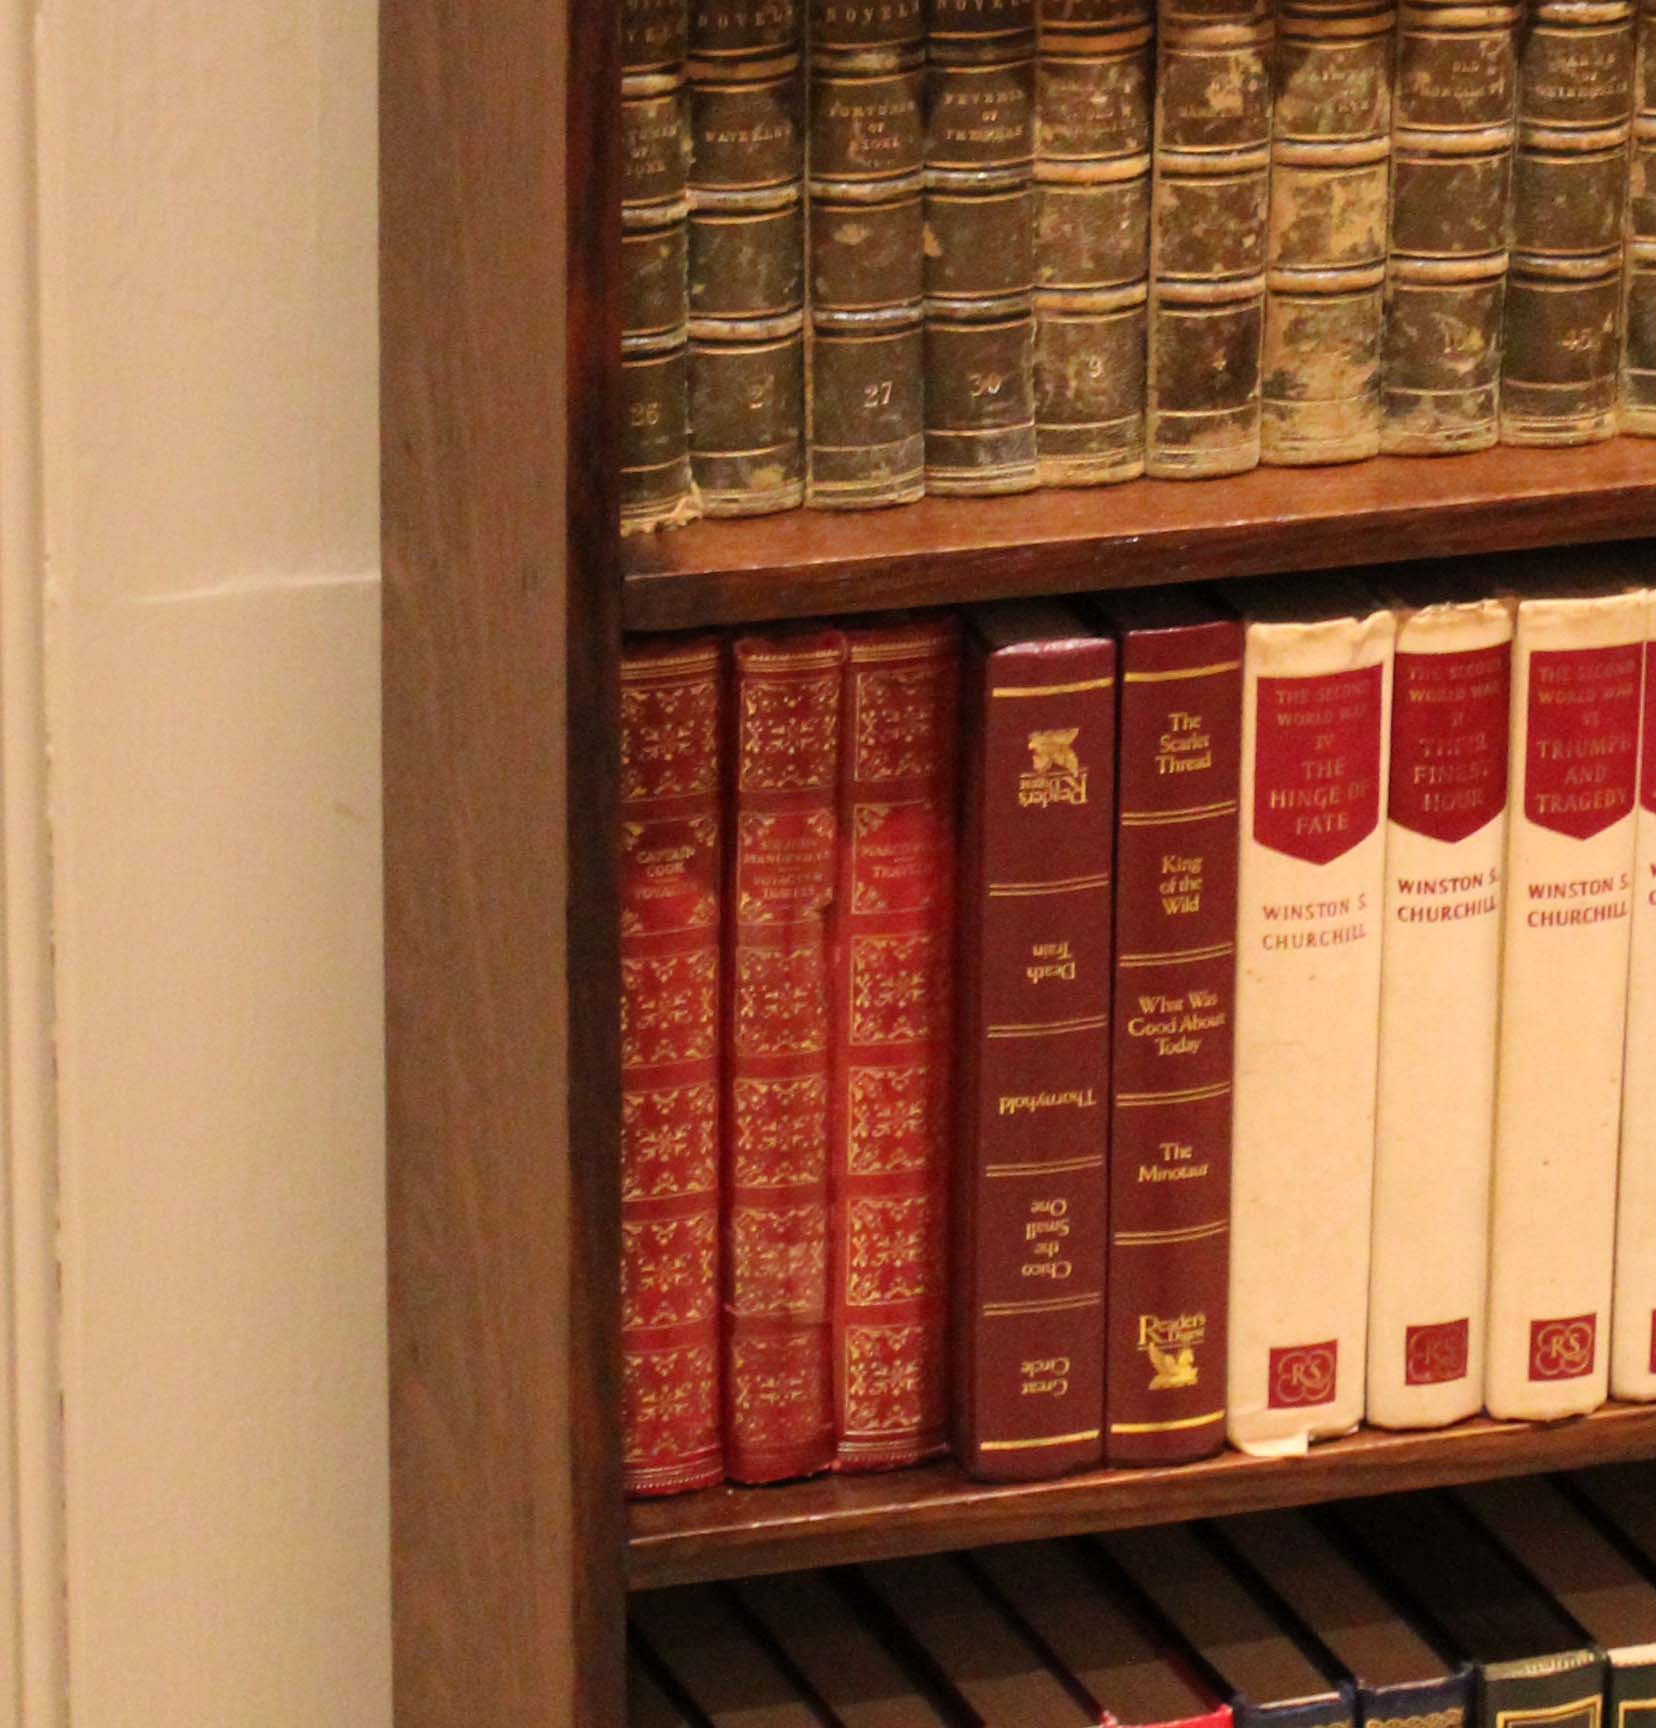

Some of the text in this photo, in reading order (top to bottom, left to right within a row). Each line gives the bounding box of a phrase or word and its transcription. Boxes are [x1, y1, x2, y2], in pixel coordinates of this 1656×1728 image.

[864, 381, 893, 408] 27
[1169, 711, 1202, 732] The
[1160, 733, 1210, 752] Scarlet
[1156, 752, 1212, 774] Thread
[1302, 758, 1346, 779] THE
[1564, 766, 1607, 785] AND
[1269, 788, 1340, 810] HINGE
[1536, 789, 1627, 815] TRAGEDY
[1296, 813, 1349, 835] FATE
[1162, 855, 1203, 874] King
[1159, 875, 1203, 894] of the
[1397, 872, 1483, 895] WINSTON
[1528, 878, 1613, 899] WINSTON
[1162, 894, 1200, 916] Wild
[1263, 900, 1350, 921] WINSTON
[1397, 896, 1497, 922] CHURCHILL
[1527, 902, 1628, 928] CHURCHILL
[1261, 924, 1367, 951] CHURCHILL
[1139, 990, 1218, 1015] What Was
[1128, 1011, 1225, 1037] Good About
[1155, 1035, 1202, 1058] Today
[999, 1088, 1096, 1114] Thornyhold
[1160, 1142, 1194, 1161] The
[1137, 1164, 1209, 1183] Minotaur
[1031, 1198, 1067, 1216] One
[1026, 1219, 1070, 1240] Small
[1138, 1313, 1206, 1346] Reader's
